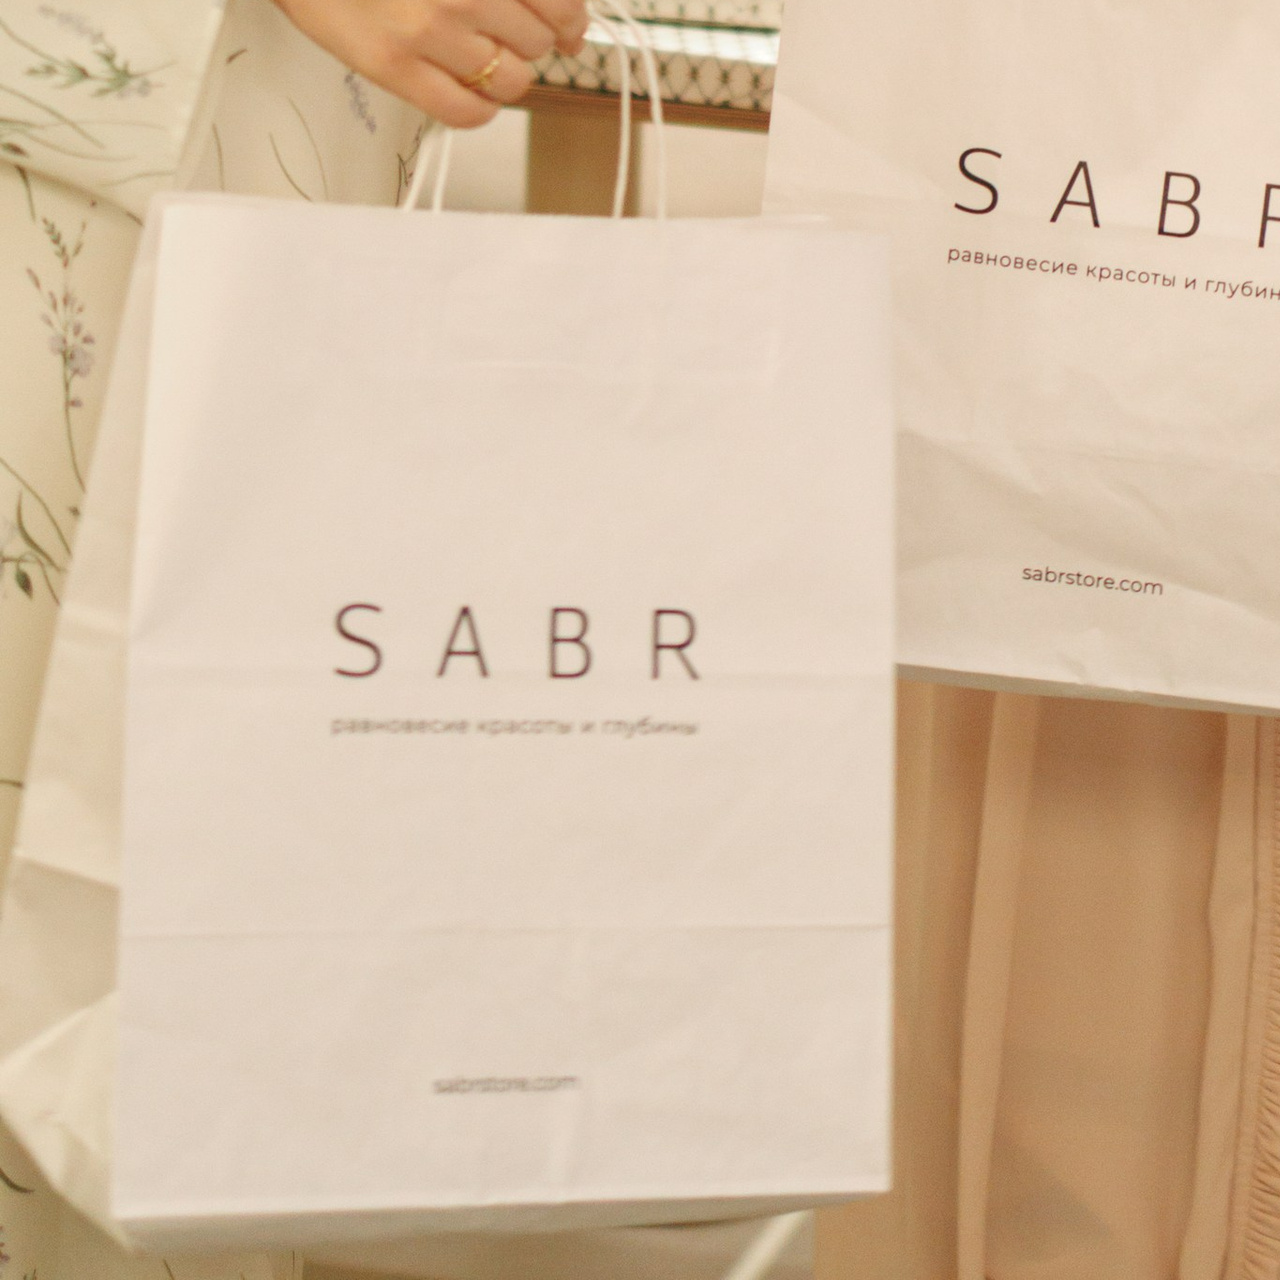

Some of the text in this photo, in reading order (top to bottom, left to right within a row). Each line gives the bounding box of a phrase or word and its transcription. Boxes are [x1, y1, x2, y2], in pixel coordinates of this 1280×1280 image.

[947, 247, 1078, 276] равновесие
[1086, 265, 1177, 288] красоты
[1184, 278, 1197, 290] и
[1022, 566, 1164, 595] sabrstore.com
[333, 603, 700, 680] SABR
